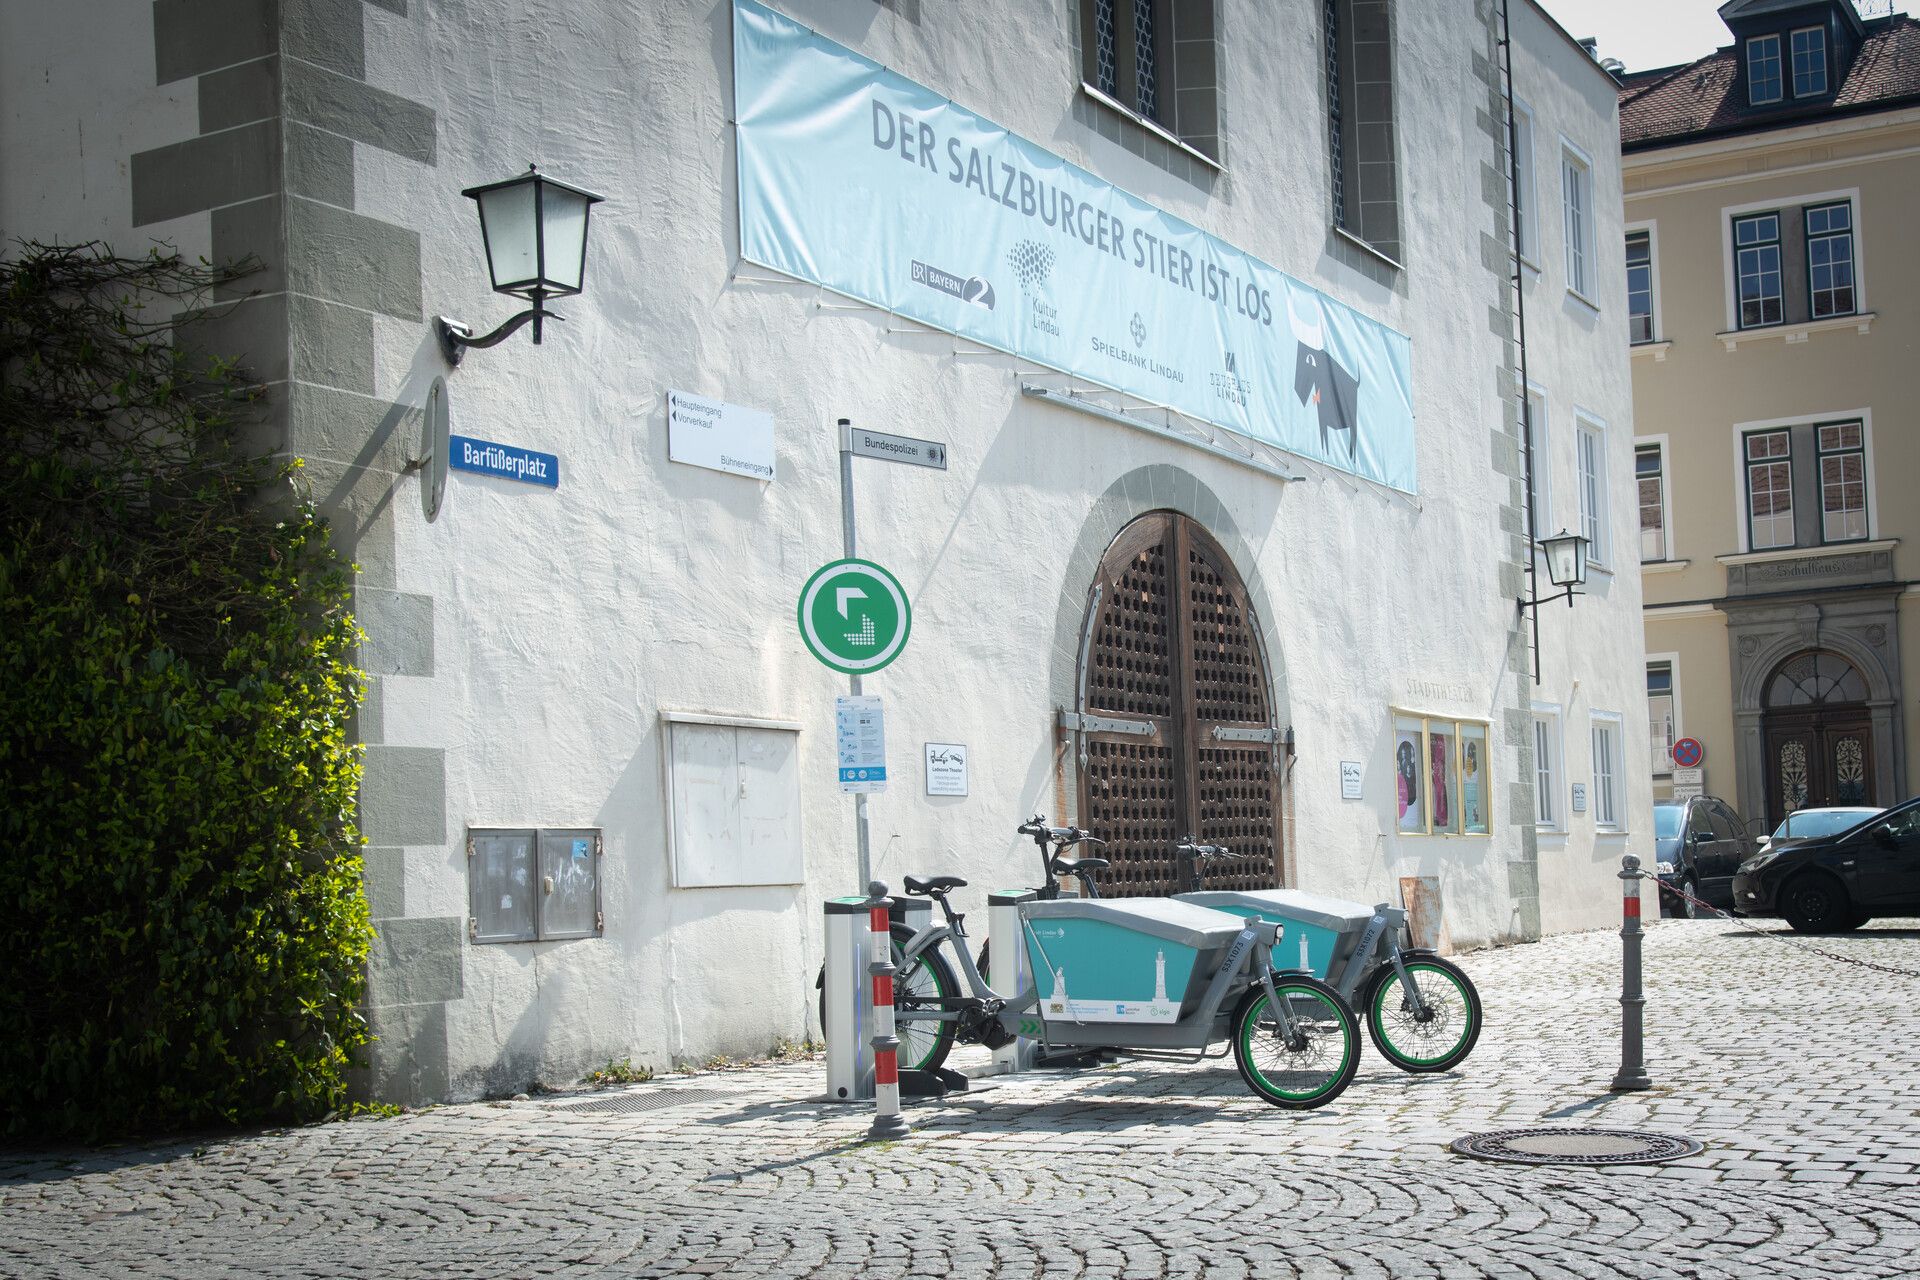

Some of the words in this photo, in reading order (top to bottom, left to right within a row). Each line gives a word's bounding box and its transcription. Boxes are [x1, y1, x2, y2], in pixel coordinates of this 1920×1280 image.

[872, 98, 938, 175] DER
[946, 136, 1127, 262] SALZBURGER
[1132, 227, 1195, 292] STIER
[1200, 259, 1230, 307] IST
[1236, 276, 1273, 327] LOS
[912, 262, 925, 282] BR
[929, 272, 961, 294] BAYERN
[969, 275, 989, 311] 2
[1032, 296, 1058, 320] Kultur
[1033, 314, 1060, 337] Lindau
[1091, 336, 1148, 370] SPIELBANK
[1149, 358, 1185, 384] LINDAU
[676, 397, 722, 419] Haupteingang
[1216, 386, 1247, 408] LINDAU
[677, 412, 713, 430] Vorverkauf
[864, 436, 919, 456] Bundespolizei
[463, 441, 548, 480] Barfüßerplatz
[720, 454, 769, 476] Bühneneingang
